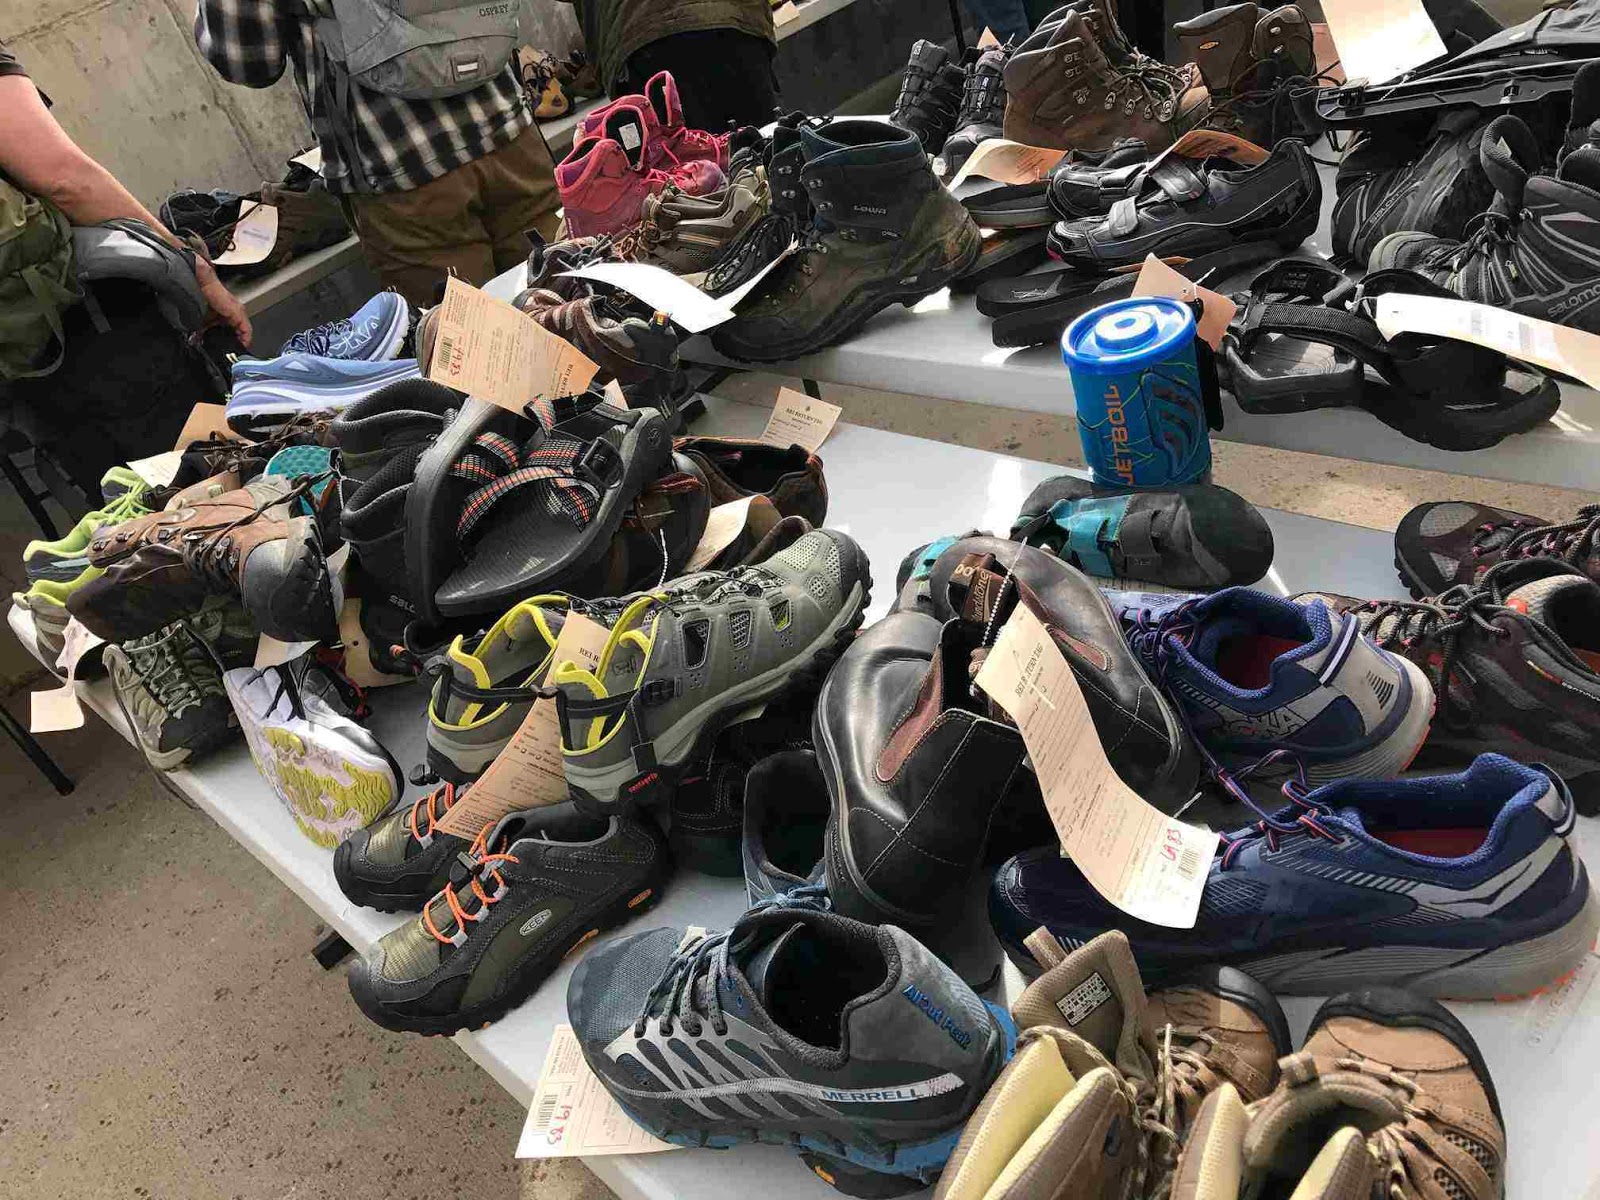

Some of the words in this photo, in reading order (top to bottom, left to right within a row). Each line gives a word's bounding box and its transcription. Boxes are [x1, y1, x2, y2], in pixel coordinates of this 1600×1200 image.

[479, 3, 509, 17] OSPREY
[1103, 384, 1136, 485] JETBOIL
[578, 646, 593, 661] REI
[521, 911, 548, 934] KEEN
[820, 1088, 923, 1101] MERRELL
